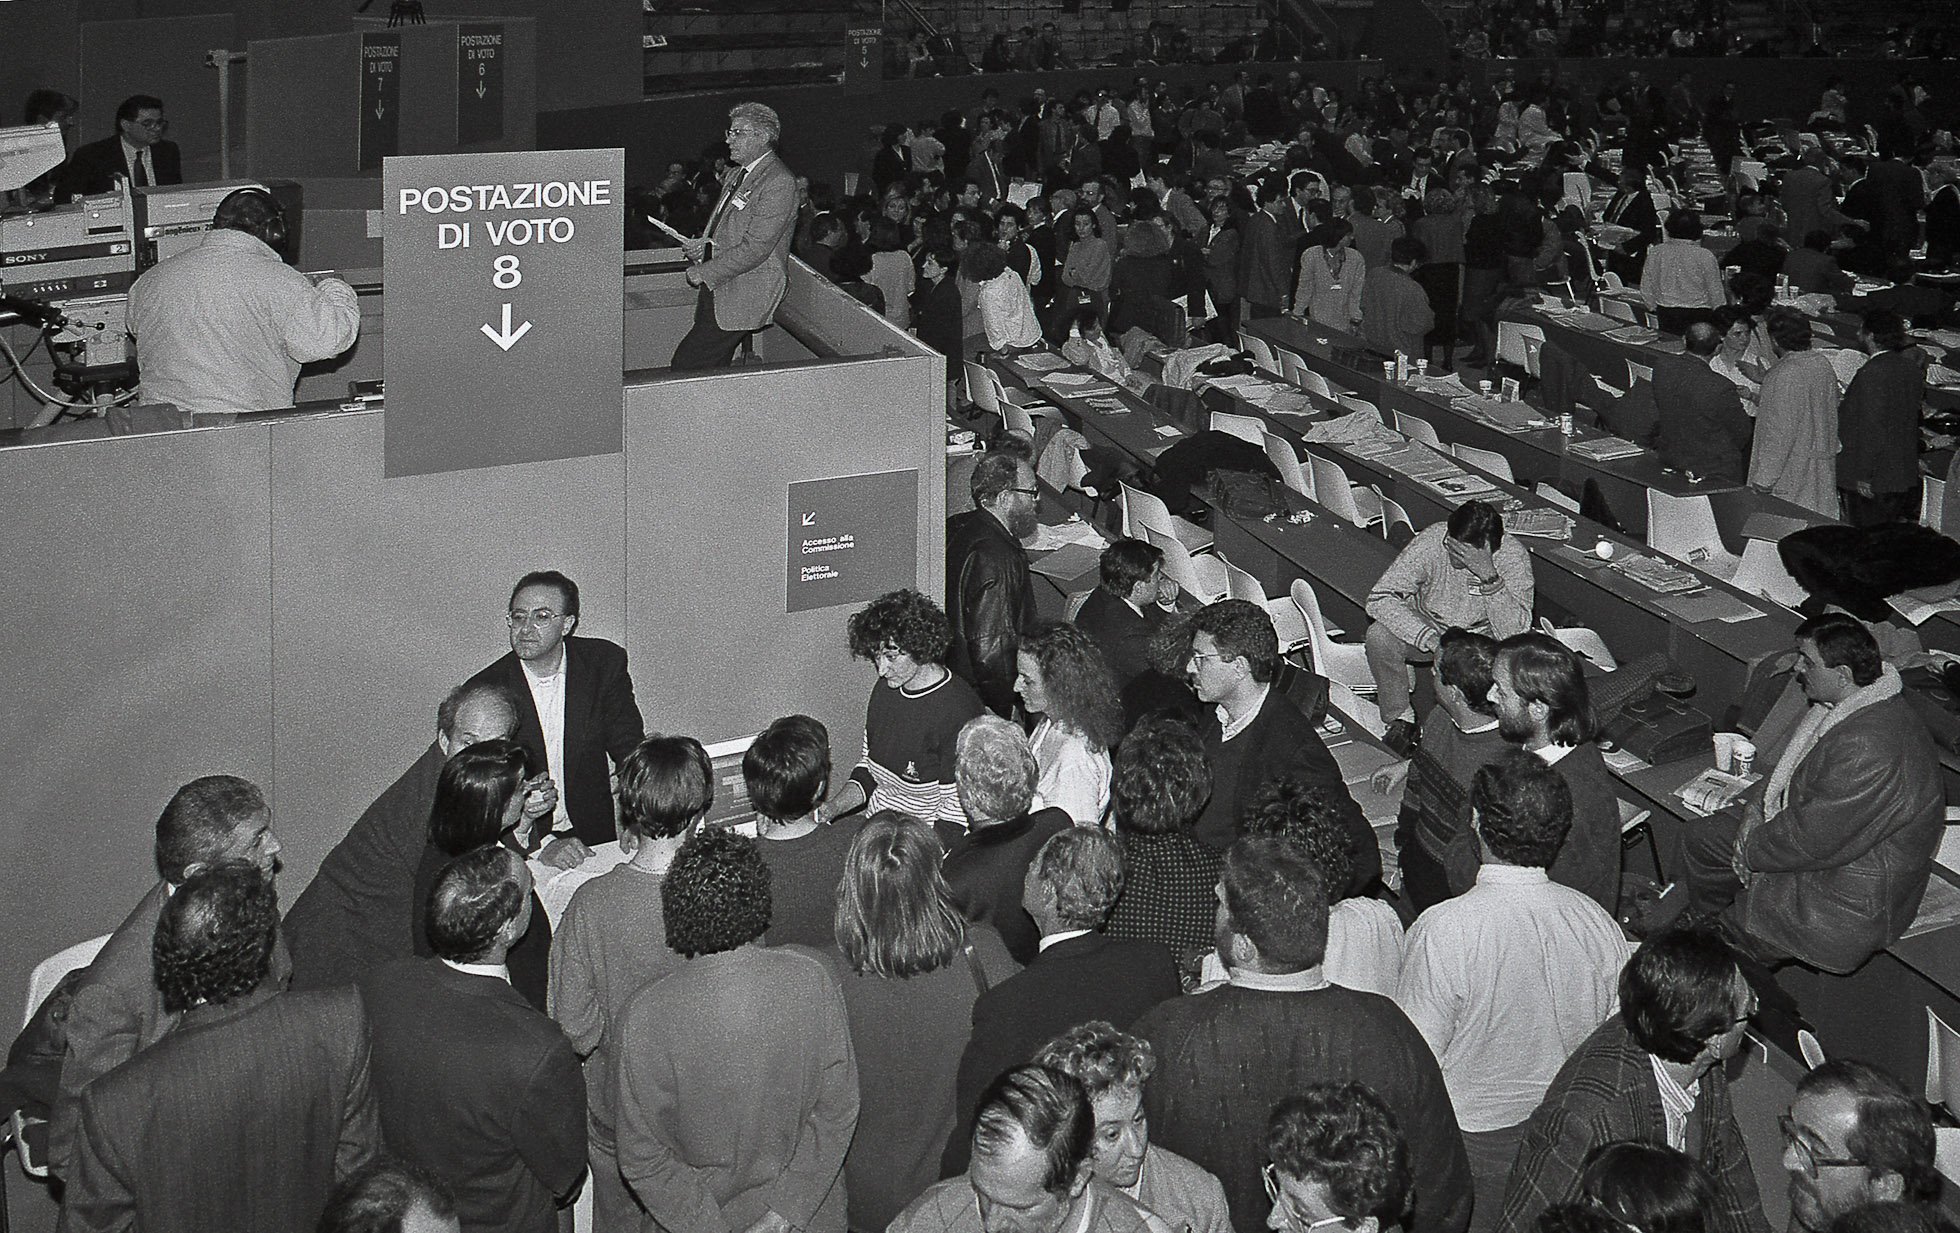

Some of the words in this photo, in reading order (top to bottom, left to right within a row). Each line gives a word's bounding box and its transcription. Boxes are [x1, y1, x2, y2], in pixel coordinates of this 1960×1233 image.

[461, 35, 502, 46] POSTAZIONE
[364, 46, 399, 57] POSTAZIONE
[468, 50, 475, 59] DI
[477, 48, 495, 59] VOTO
[862, 46, 867, 54] 5
[370, 62, 376, 73] DI
[378, 61, 393, 73] VOTO
[479, 63, 485, 75] 6
[378, 78, 383, 91] 7
[399, 180, 611, 215] POSTAZIONE
[438, 222, 470, 250] DI
[485, 216, 576, 246] VOTO
[115, 244, 123, 253] 2
[5, 253, 48, 264] SONY
[492, 254, 523, 290] 8
[802, 537, 837, 546] Accesso
[840, 534, 853, 542] alla
[802, 542, 854, 554] Commissione
[801, 565, 830, 574] Politica
[801, 571, 839, 581] Elettorale
